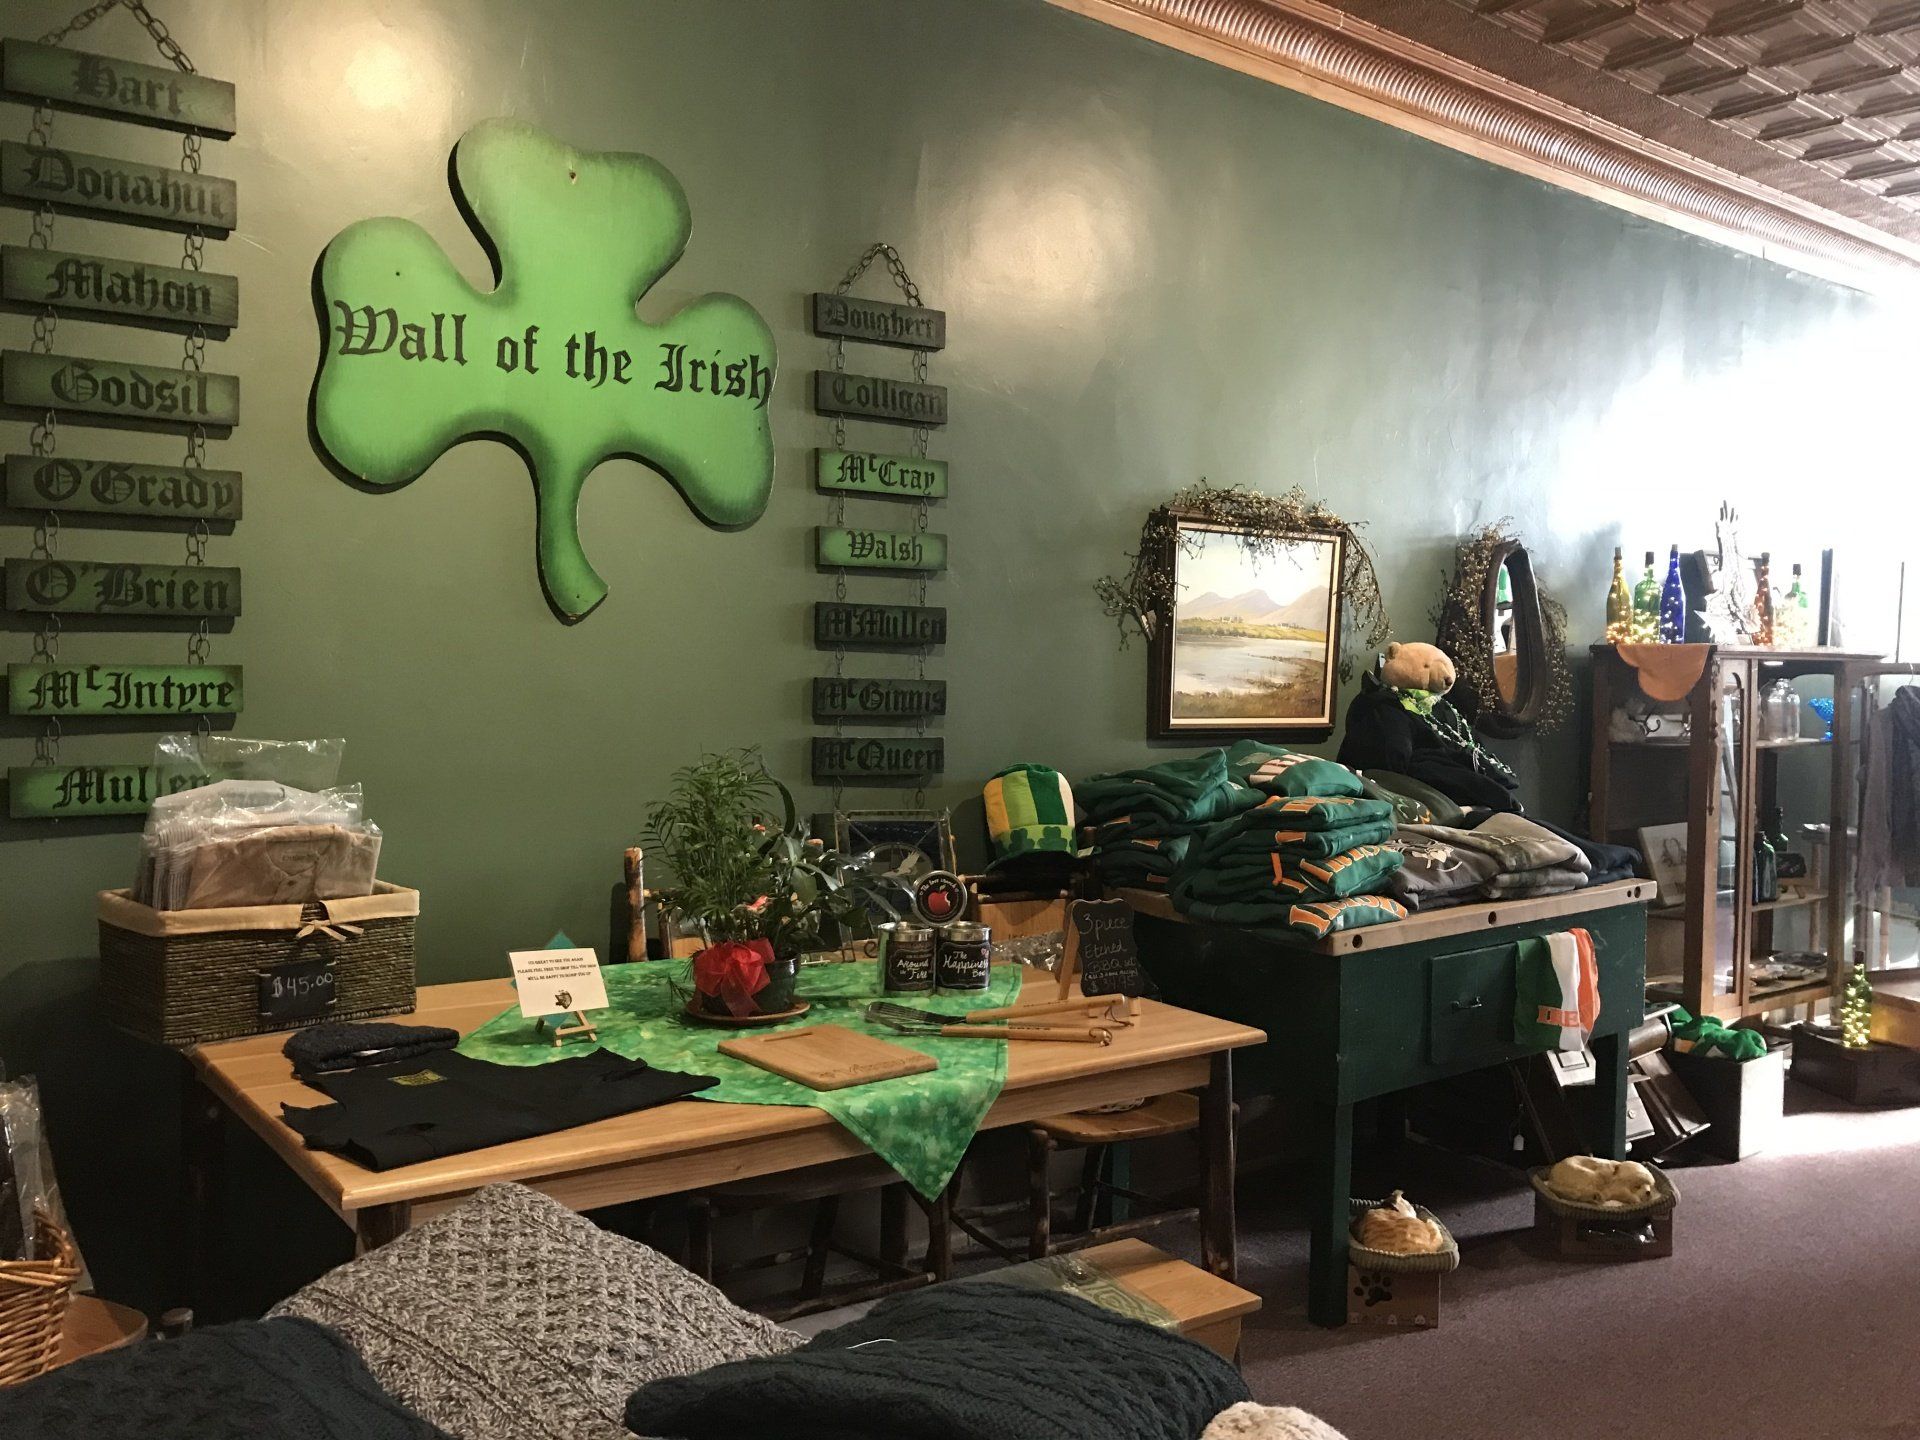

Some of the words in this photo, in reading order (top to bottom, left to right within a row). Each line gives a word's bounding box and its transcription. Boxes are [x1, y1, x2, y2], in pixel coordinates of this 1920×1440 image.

[46, 257, 212, 317] Mahon
[334, 300, 468, 366] Wall
[496, 325, 540, 375] of
[565, 331, 632, 388] the
[654, 343, 772, 410] Irish
[51, 362, 209, 416] Godsil
[34, 458, 234, 516] O'Grady
[836, 453, 935, 496] McCray
[847, 530, 922, 567] Walsh
[25, 561, 229, 611] O'Brien
[28, 664, 234, 712] McIntyre
